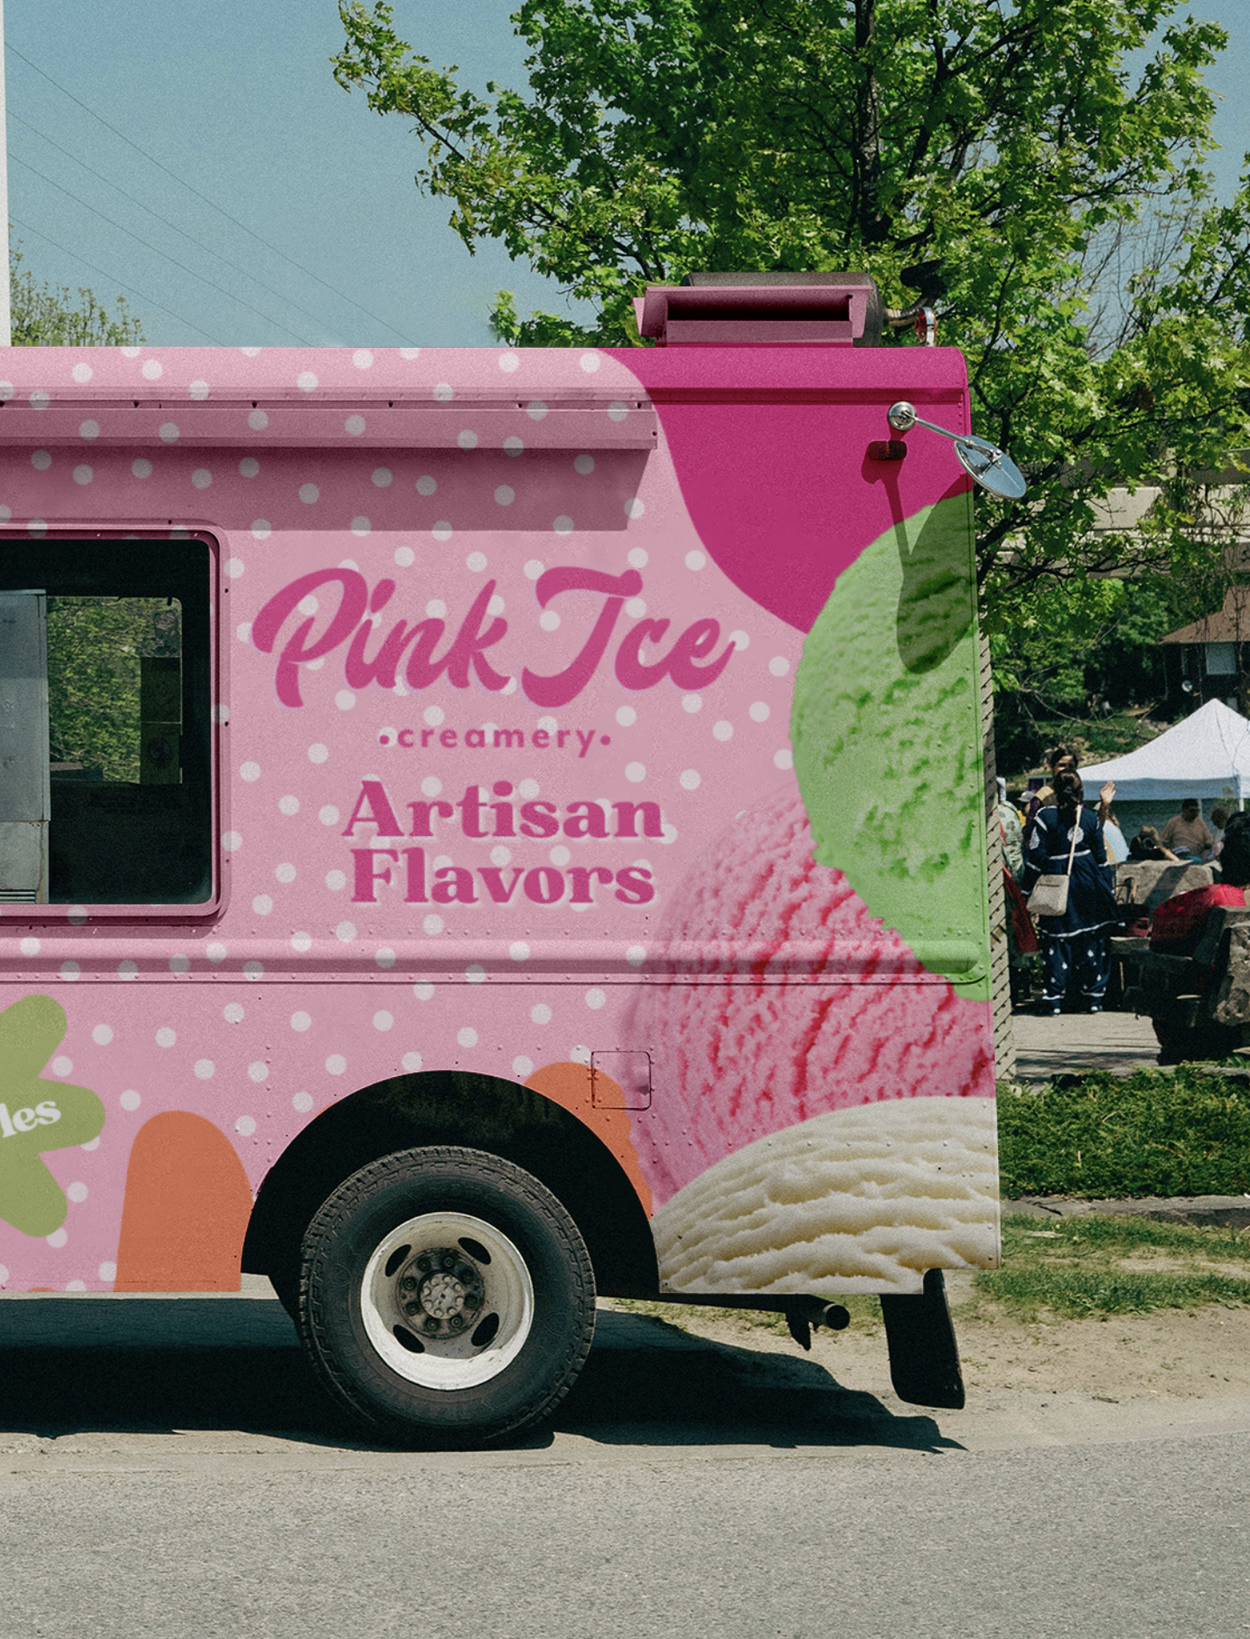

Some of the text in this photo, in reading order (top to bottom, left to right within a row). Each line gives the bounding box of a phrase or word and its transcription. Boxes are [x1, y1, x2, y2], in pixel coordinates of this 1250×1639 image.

[252, 566, 737, 708] Pink Ice
[342, 779, 665, 838] Artisan
[350, 847, 655, 904] Flavors
